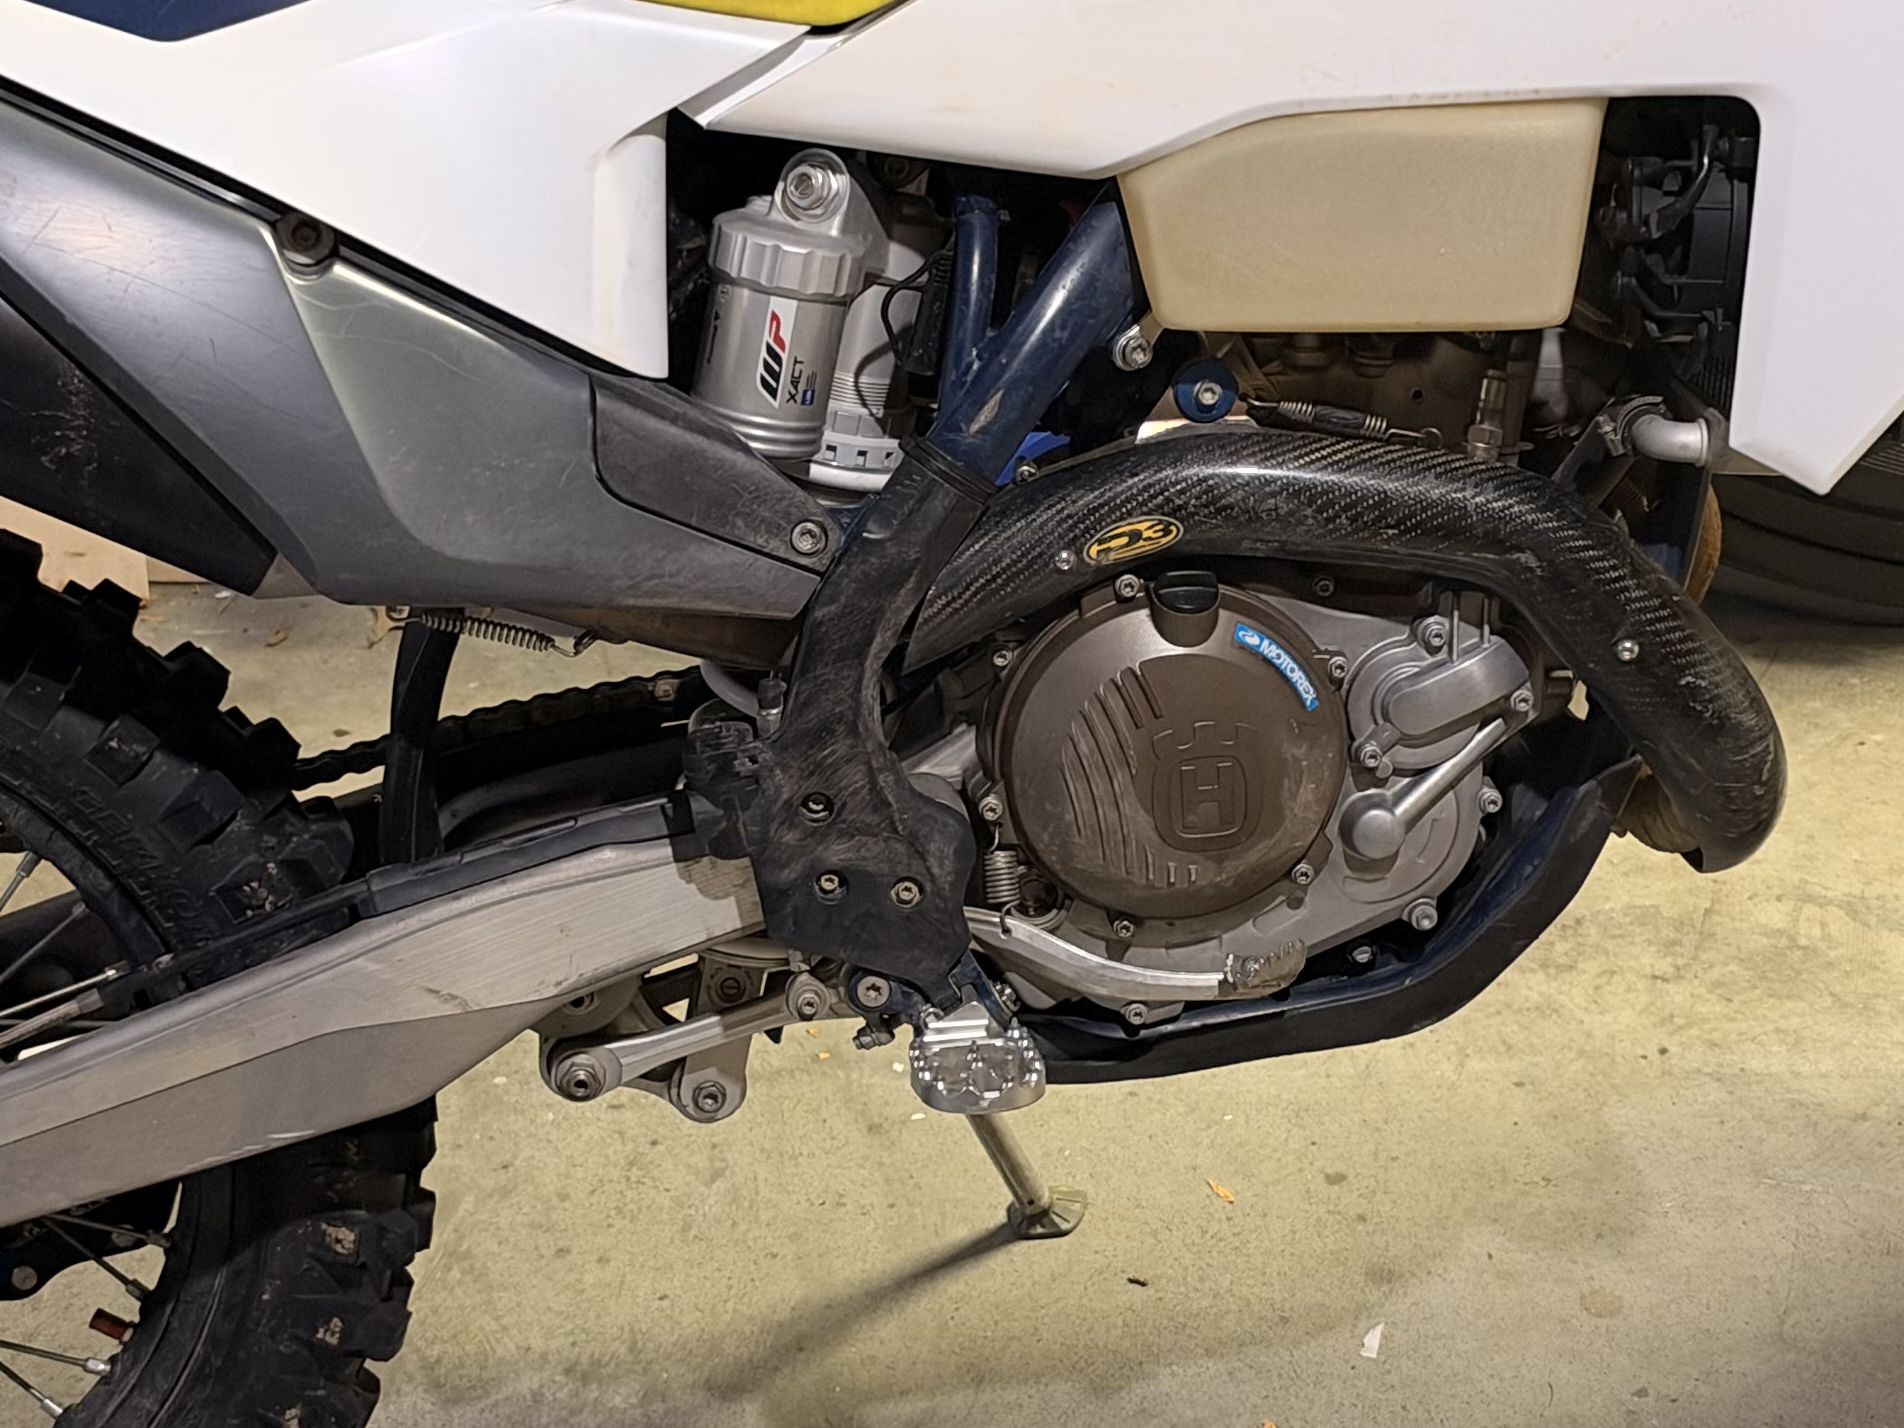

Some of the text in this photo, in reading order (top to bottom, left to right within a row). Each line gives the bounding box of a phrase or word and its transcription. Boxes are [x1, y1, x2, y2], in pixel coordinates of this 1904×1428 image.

[760, 309, 786, 402] WP
[786, 356, 805, 405] XACT
[1259, 639, 1319, 705] MOTOREX
